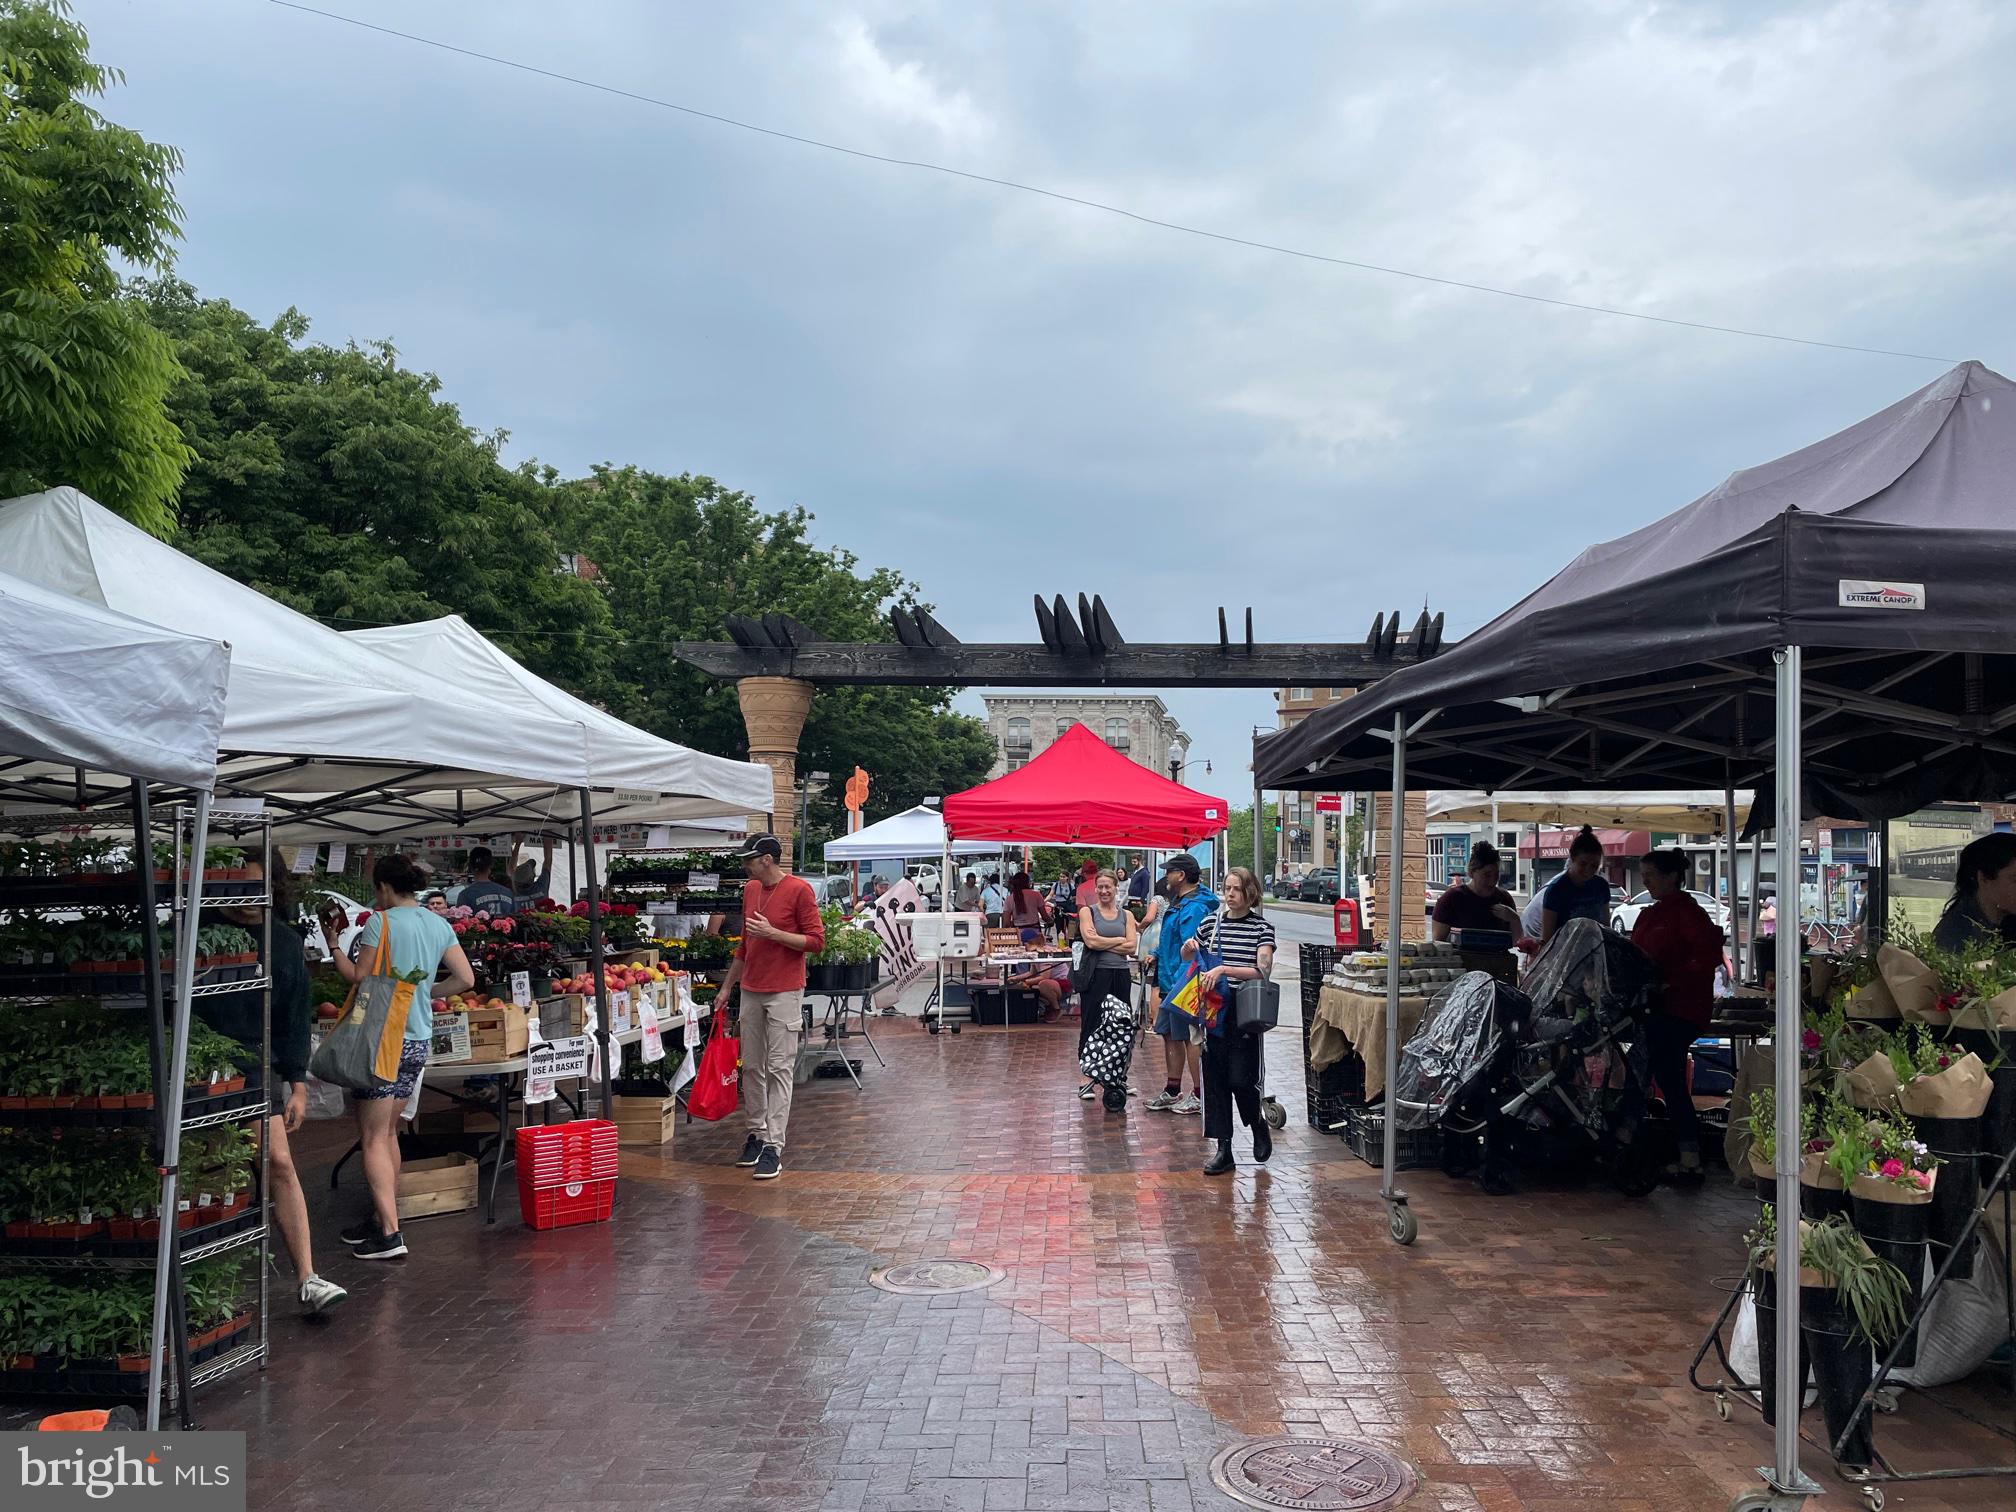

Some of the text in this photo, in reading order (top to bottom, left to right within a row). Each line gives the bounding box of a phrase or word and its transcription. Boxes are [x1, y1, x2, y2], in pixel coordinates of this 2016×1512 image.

[1846, 594, 1881, 602] EXTREME
[531, 1047, 585, 1065] shopping convenience
[532, 1060, 584, 1076] USE A BASKET
